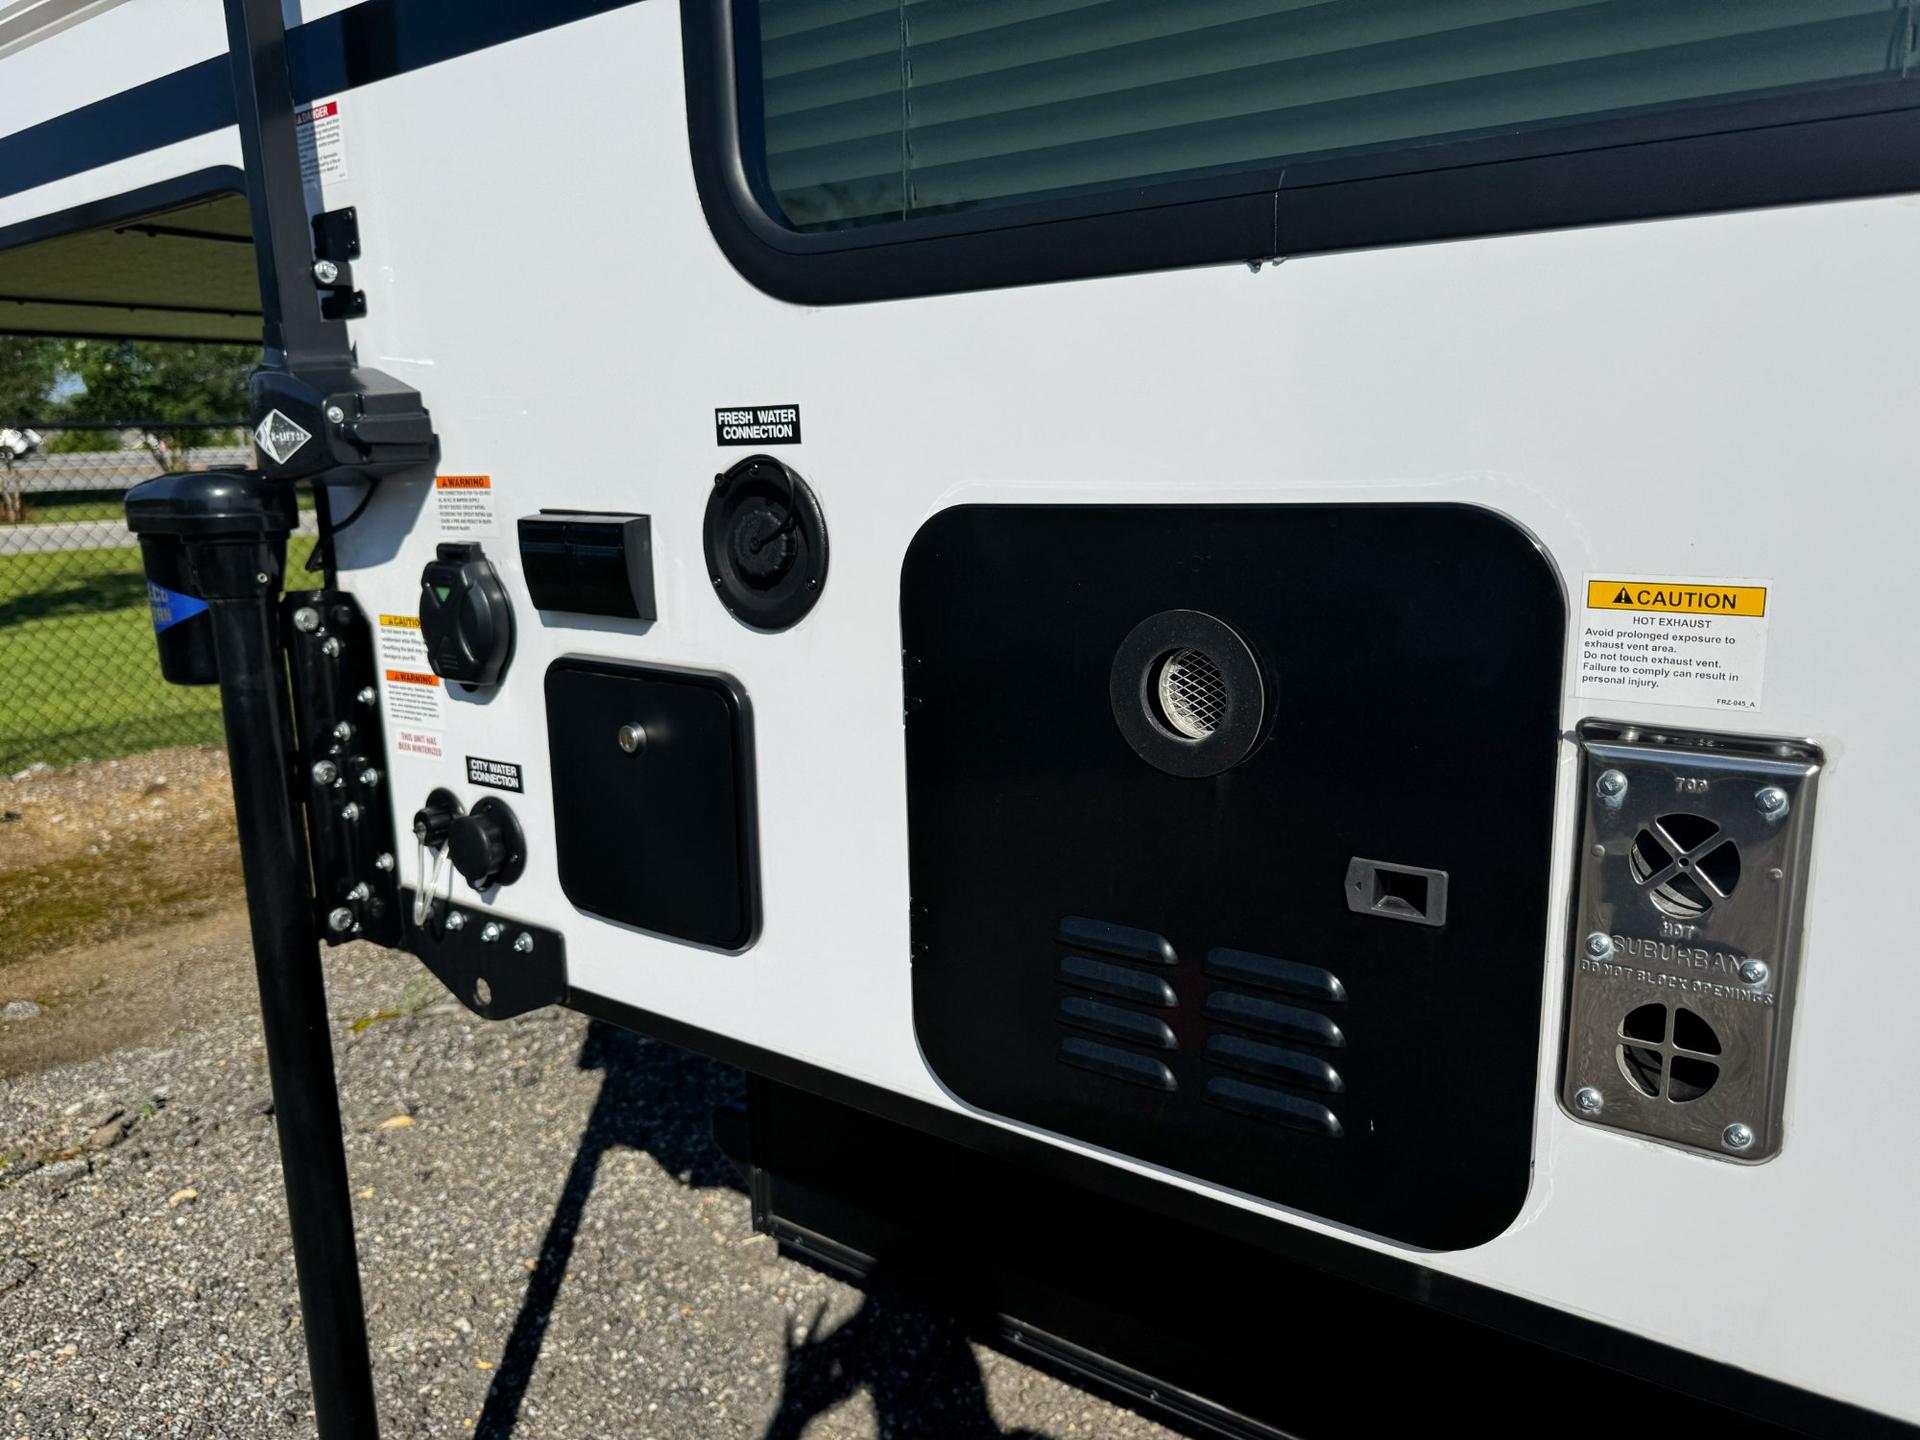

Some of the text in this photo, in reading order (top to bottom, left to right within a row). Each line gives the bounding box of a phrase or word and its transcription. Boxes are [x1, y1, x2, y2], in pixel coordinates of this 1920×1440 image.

[717, 409, 796, 425] FRESH WATER
[723, 424, 793, 439] CONNECTION
[448, 477, 484, 488] WARNING
[1637, 590, 1737, 609] CAUTION
[395, 616, 421, 627] CAUTIO
[1633, 616, 1712, 628] HOT EXHAUST
[1585, 627, 1736, 645] Avoid prolonged exposure to
[1584, 640, 1677, 653] exhaust vent area.
[1584, 650, 1721, 668] Do not touch exhaust vent.
[400, 672, 433, 684] WARNING
[1583, 662, 1739, 681] Failure to comply can result in
[1582, 675, 1659, 688] personal injury.
[471, 760, 517, 777] CITY WATER
[471, 770, 519, 788] CONNECTION
[1674, 776, 1709, 793] TOP
[1662, 921, 1697, 940] HOT
[1611, 934, 1747, 977] SUBURBAN
[1581, 959, 1774, 1004] DO NOT BLOCK OPENINGS
